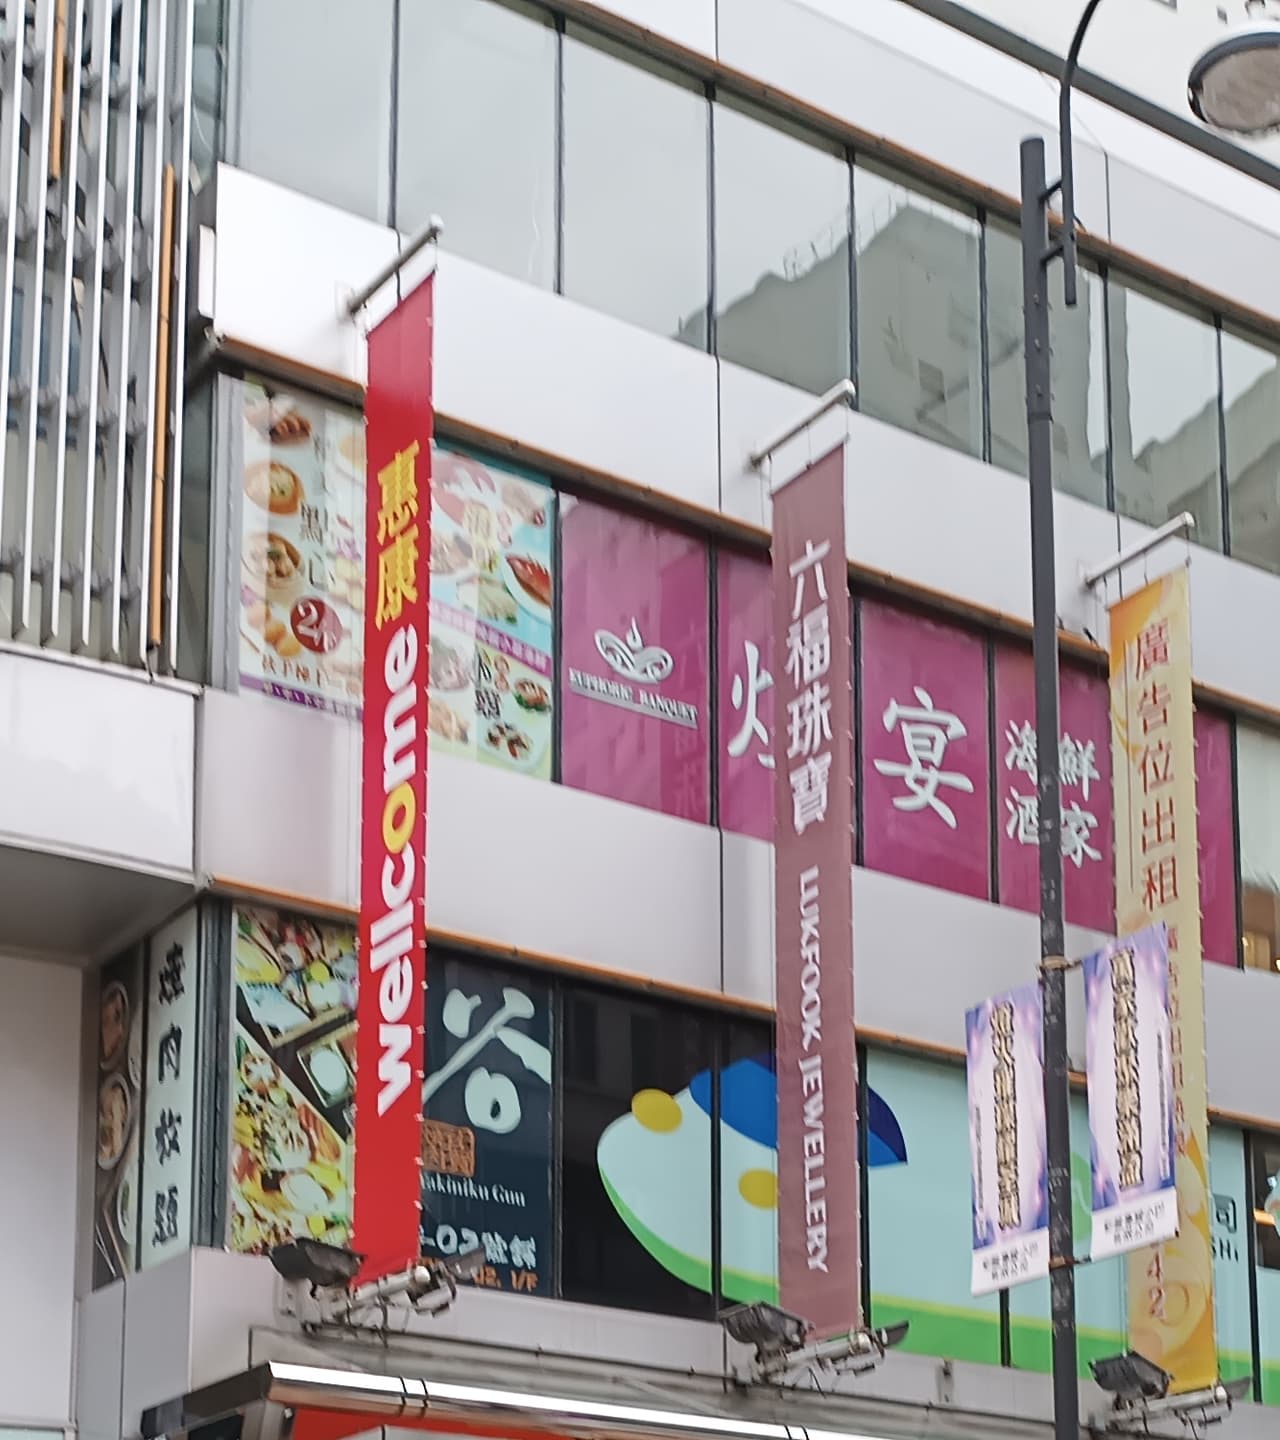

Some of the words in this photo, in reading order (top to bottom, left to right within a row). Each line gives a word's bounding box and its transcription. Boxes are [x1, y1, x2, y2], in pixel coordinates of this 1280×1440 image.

[375, 440, 420, 631] 惠康
[785, 539, 834, 836] 六福珠寶
[1134, 618, 1180, 912] 廣告位出租
[369, 622, 419, 1118] wellcome
[798, 864, 823, 1054] LUKFOOK
[420, 1171, 490, 1202] akiniku
[800, 1056, 829, 1274] JEWELLERY
